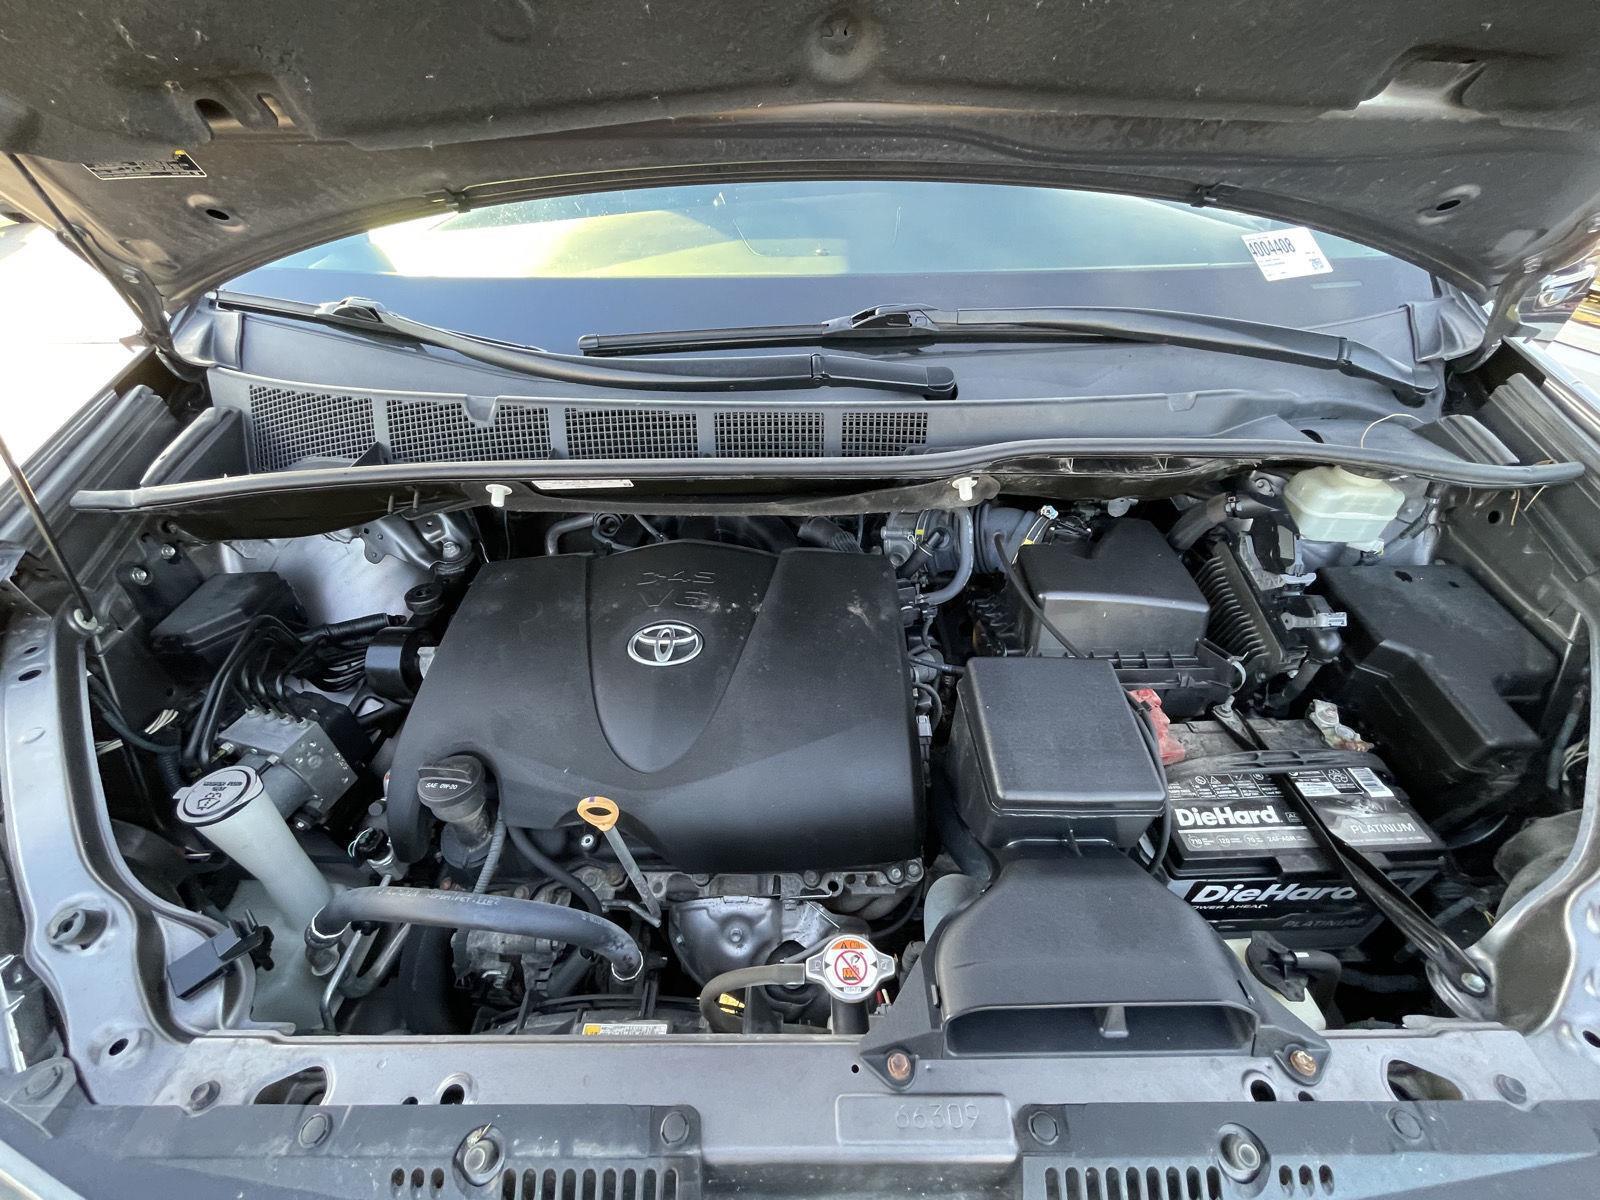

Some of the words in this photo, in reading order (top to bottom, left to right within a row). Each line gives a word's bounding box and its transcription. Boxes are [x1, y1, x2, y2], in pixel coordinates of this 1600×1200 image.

[1174, 805, 1281, 827] DieHard
[1350, 822, 1417, 835] PLATINUM
[895, 1103, 980, 1130] 66309
